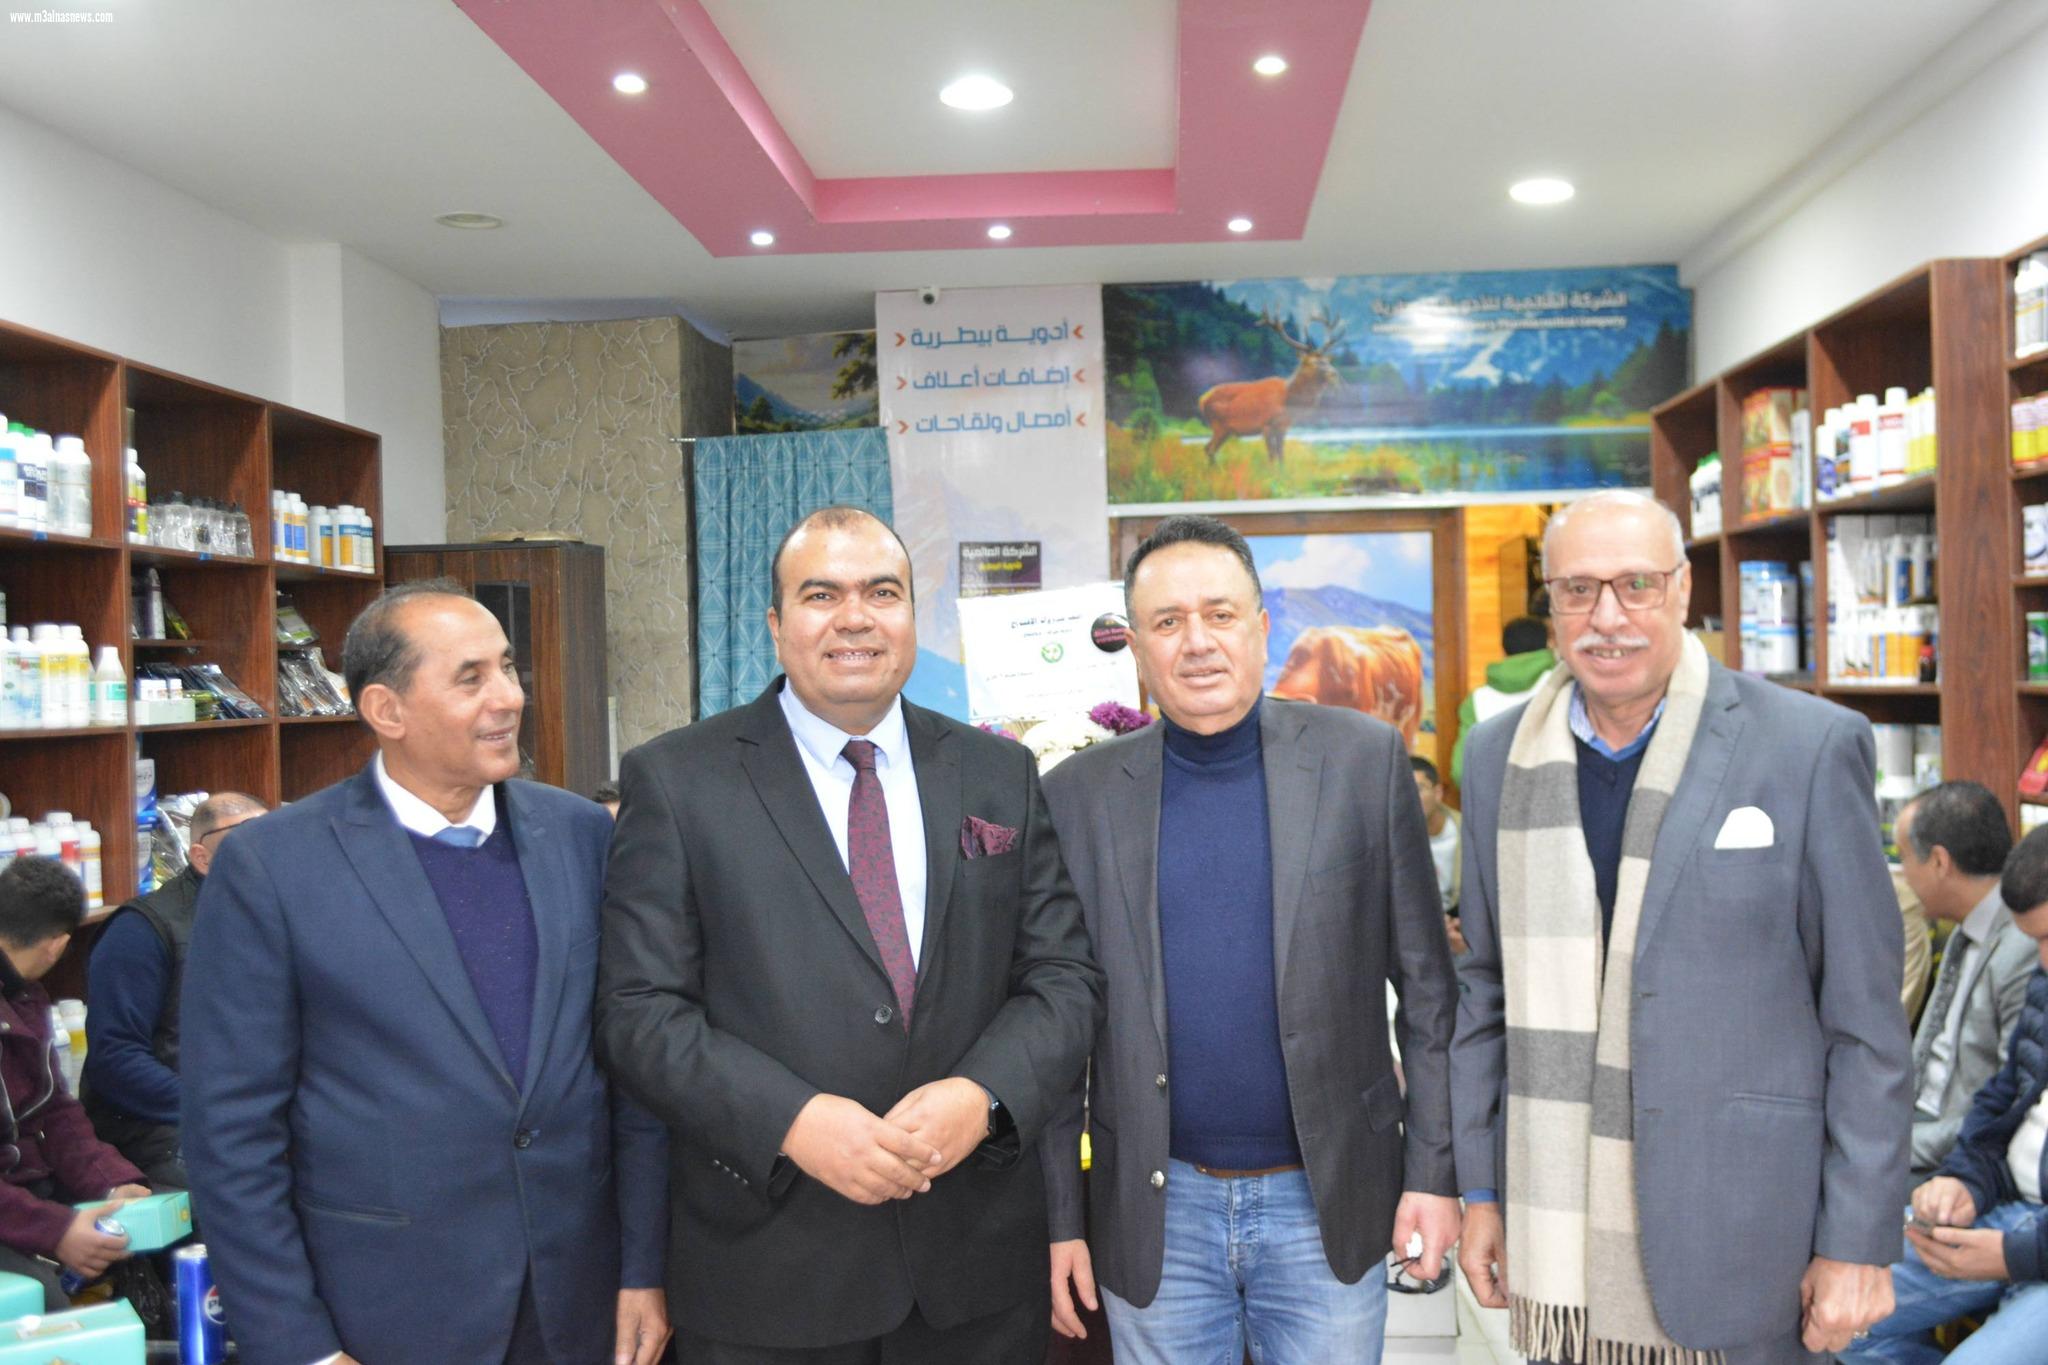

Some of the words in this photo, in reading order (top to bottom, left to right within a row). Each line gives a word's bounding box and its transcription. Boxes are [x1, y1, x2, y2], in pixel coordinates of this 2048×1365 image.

[910, 326, 993, 349] بيطرية
[996, 317, 1069, 346] أدوية
[912, 364, 980, 390] أعلاف
[983, 365, 1070, 389] إضافات
[915, 411, 1003, 434] ولقاحات
[1006, 406, 1071, 433] أمصال
[1002, 543, 1038, 559] الشركة
